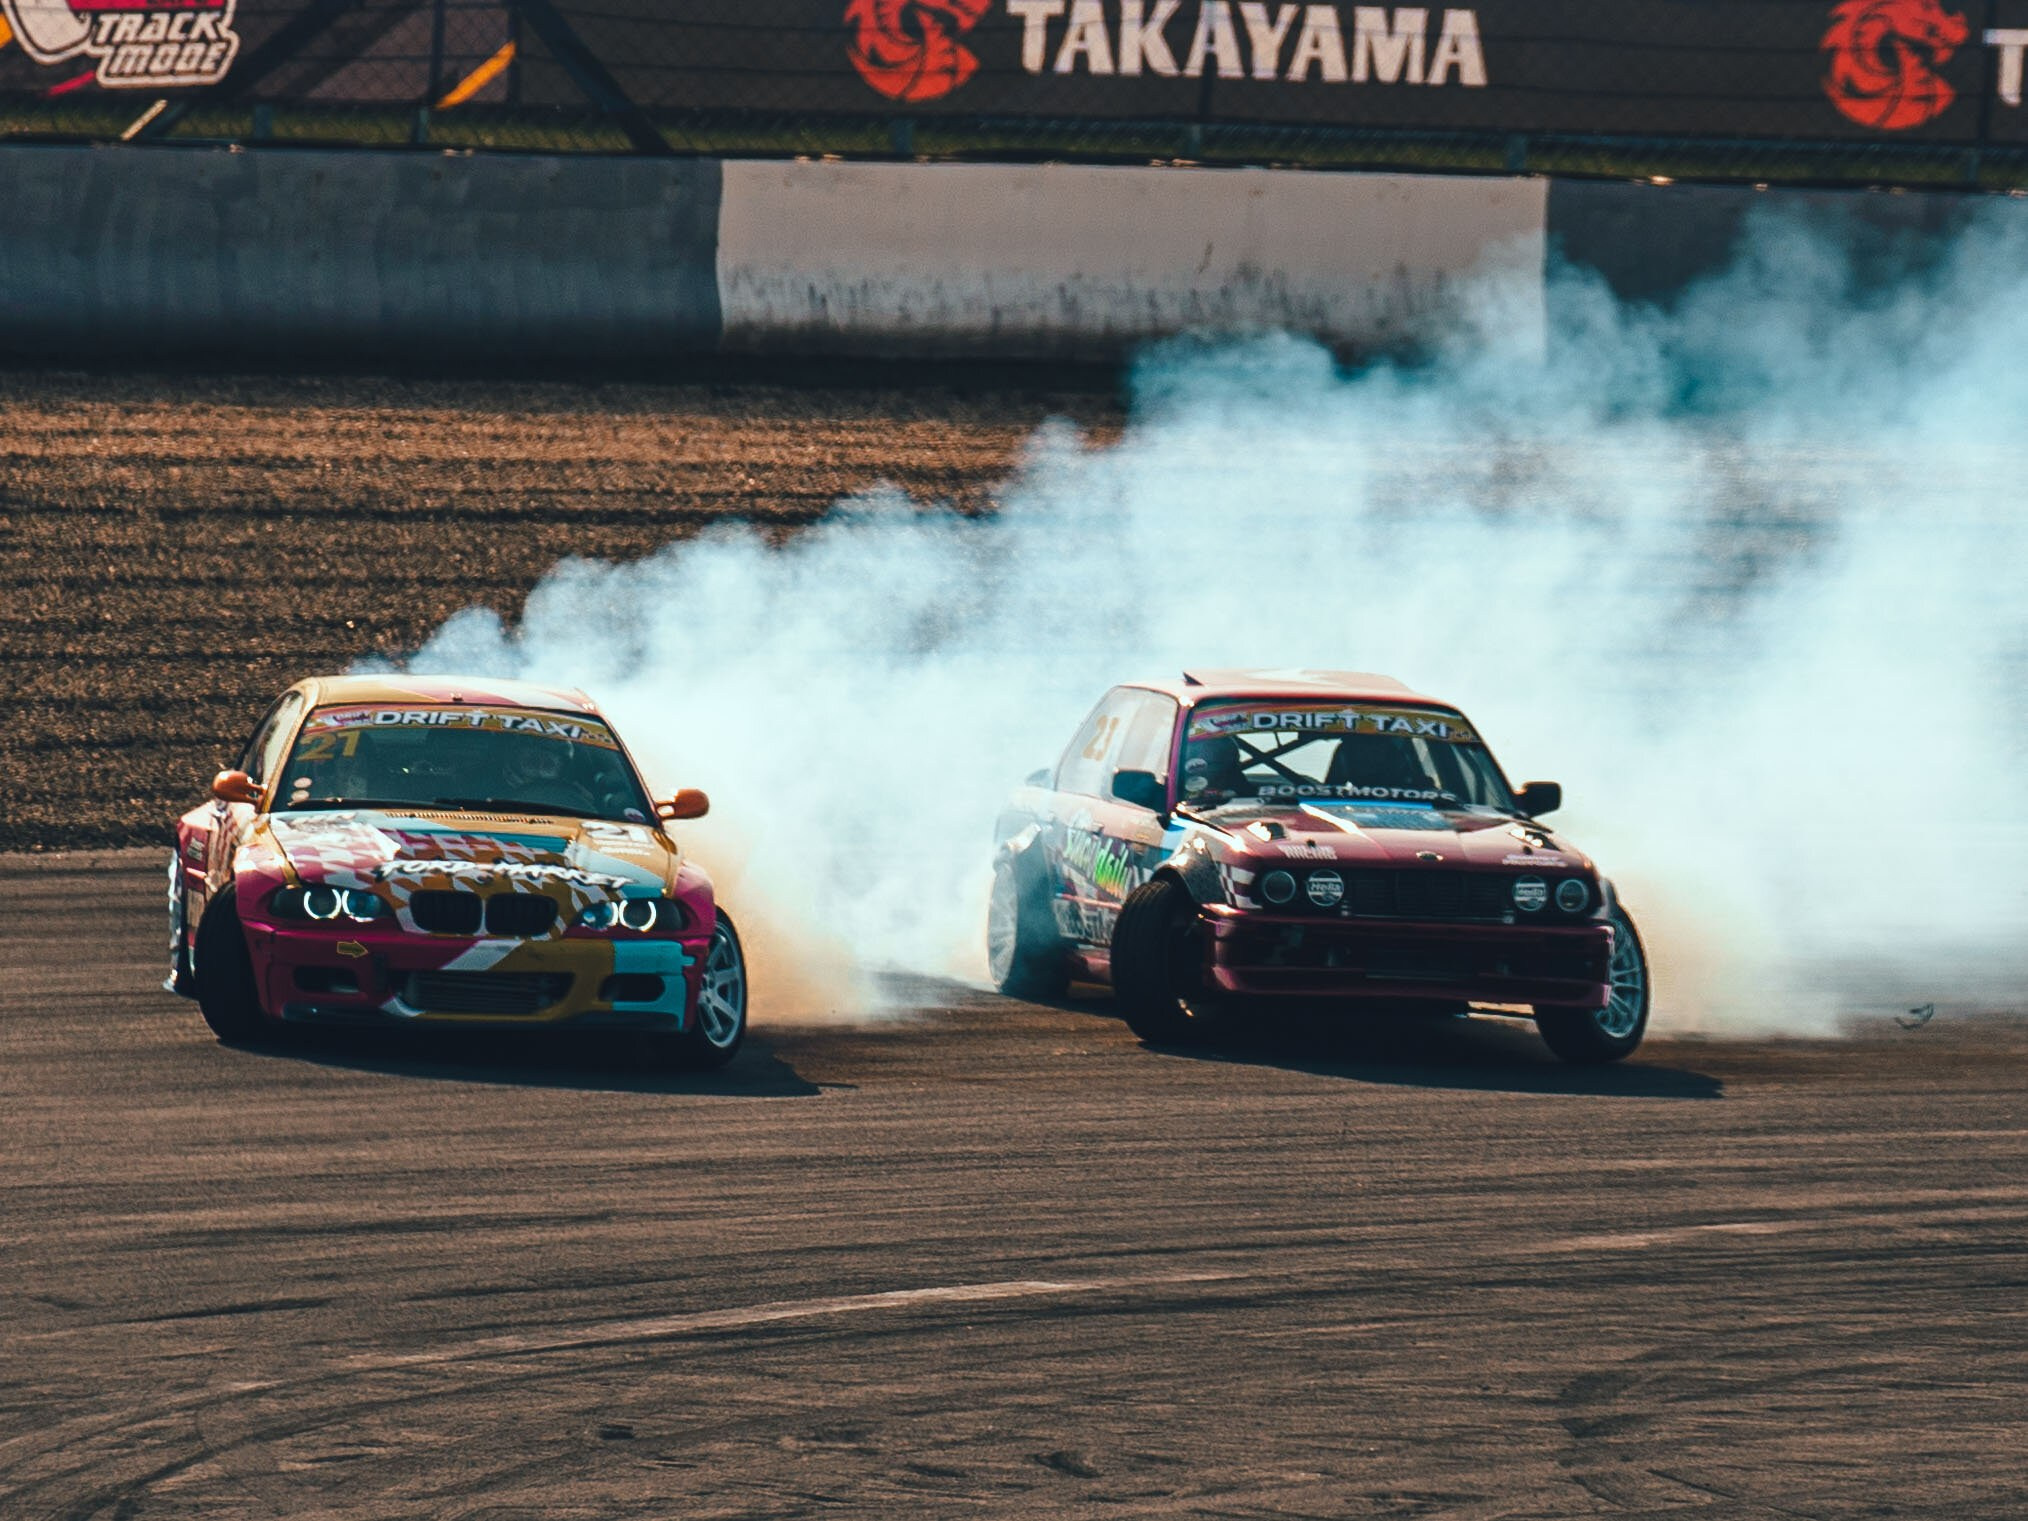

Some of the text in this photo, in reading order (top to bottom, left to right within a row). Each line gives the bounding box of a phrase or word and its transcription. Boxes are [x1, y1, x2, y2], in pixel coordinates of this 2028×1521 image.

[96, 12, 221, 45] TRACK
[1008, 0, 1487, 87] TAKAYAMA
[108, 43, 228, 76] MODE
[374, 710, 490, 727] DRIFT
[499, 713, 583, 739] TAXI
[1252, 710, 1361, 730] DRIFT
[1367, 715, 1448, 738] TAXI
[297, 730, 362, 762] 21
